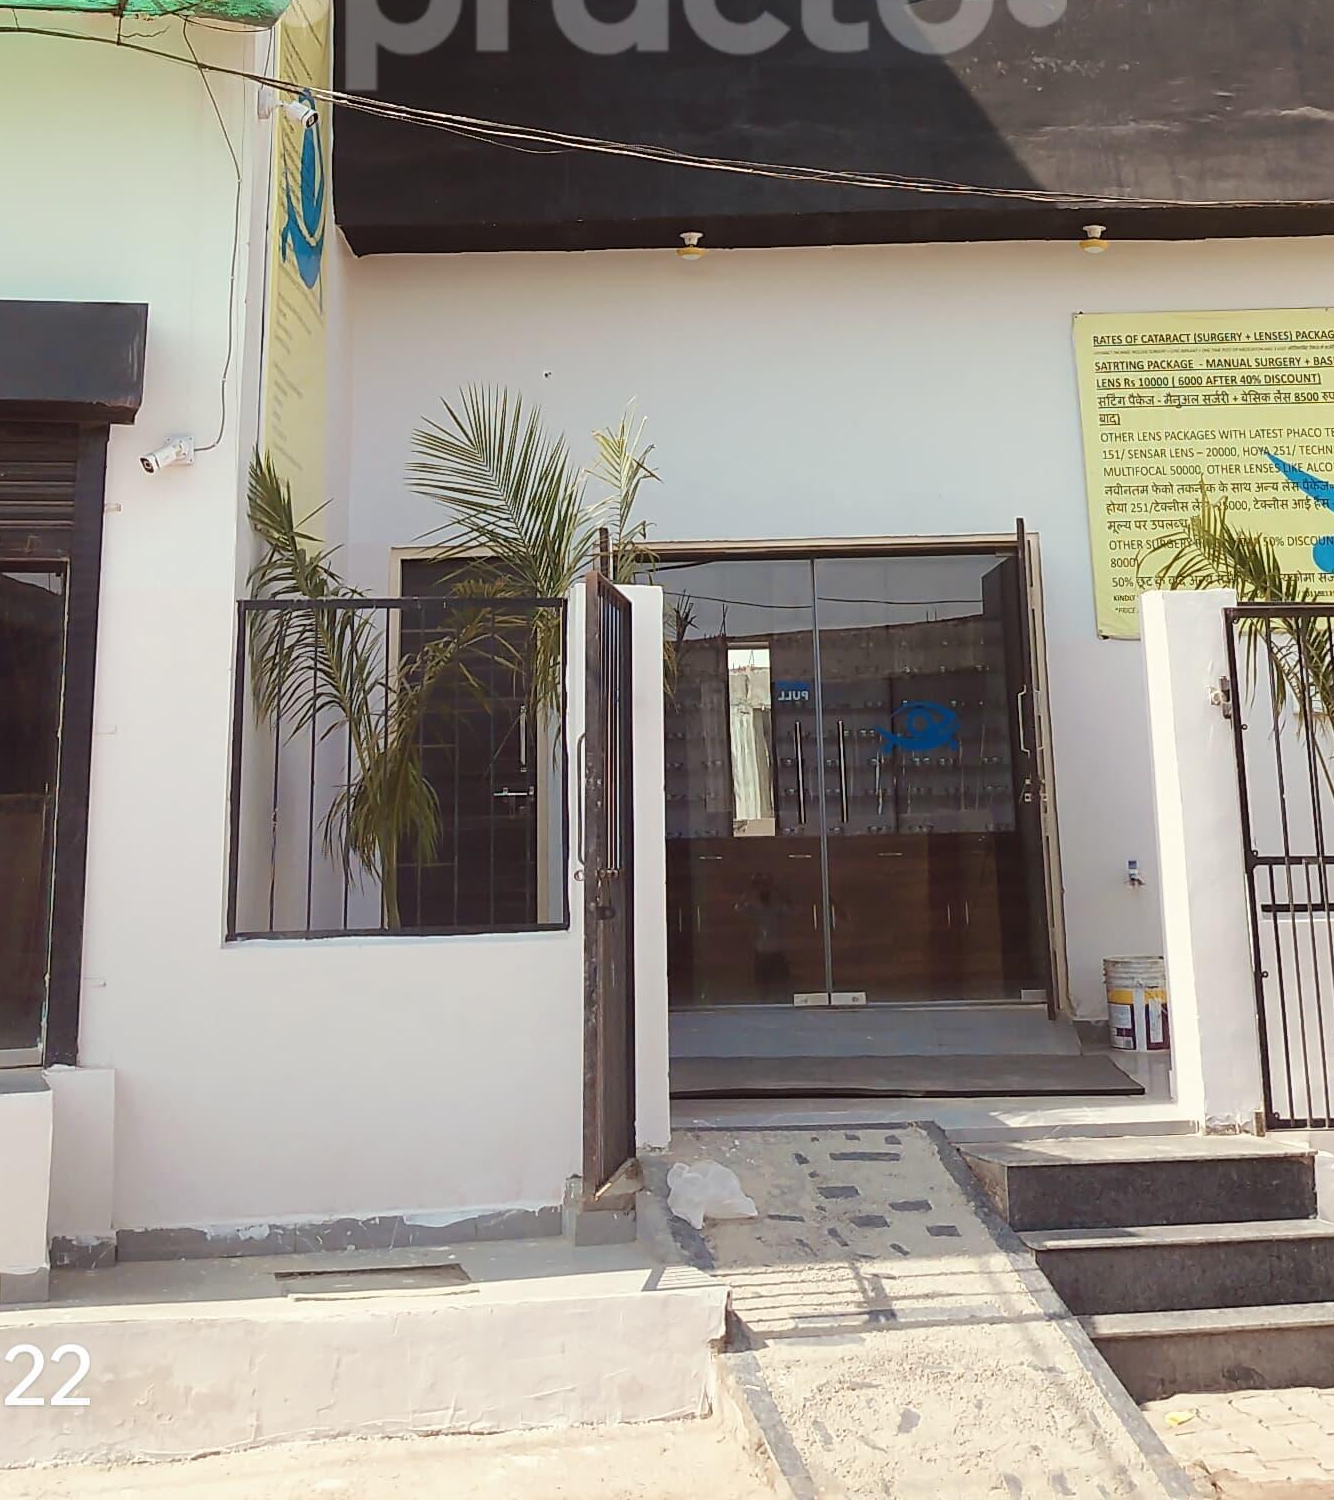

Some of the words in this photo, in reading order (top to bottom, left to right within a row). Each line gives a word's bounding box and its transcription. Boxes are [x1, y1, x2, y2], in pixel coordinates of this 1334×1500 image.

[1093, 335, 1123, 345] RATES
[1126, 334, 1138, 344] OF
[1141, 334, 1191, 343] CATARACT
[1147, 359, 1193, 370] PACKAGE
[1206, 358, 1252, 368] MANUAL
[1254, 357, 1302, 367] SURGERY
[1096, 377, 1121, 389] LENS
[1124, 378, 1135, 387] Rs
[1138, 377, 1168, 387] 10000
[1178, 376, 1202, 386] 6000
[1205, 375, 1237, 385] AFTER
[1240, 375, 1261, 384] 40%
[1294, 391, 1318, 401] 8500
[1100, 432, 1134, 443] OTHER
[1137, 431, 1161, 442] LENS
[1164, 430, 1216, 441] PACKAGES
[1219, 429, 1246, 440] WITH
[1249, 428, 1283, 439] LATEST
[1286, 428, 1321, 438] PHACO
[1127, 448, 1167, 459] SENSAR
[1170, 448, 1195, 457] LENS
[1243, 445, 1270, 456] HOYA
[1103, 465, 1168, 476] MULTIFOCAL
[1207, 463, 1241, 474] OTHER
[1243, 463, 1280, 473] LENSES
[1283, 462, 1303, 473] LIKE
